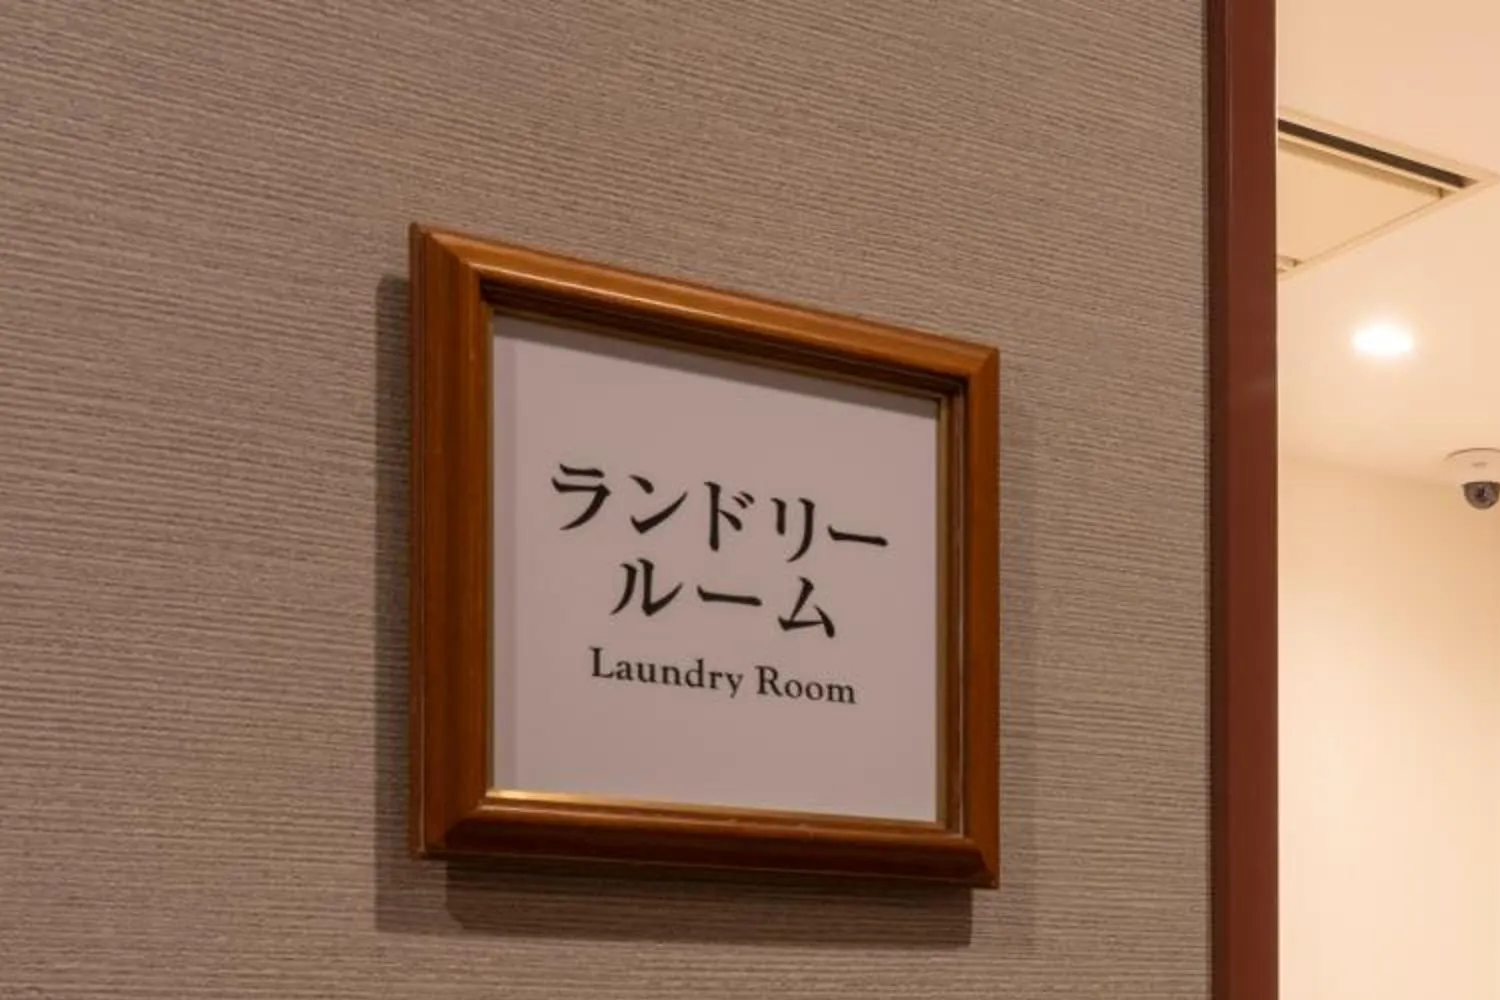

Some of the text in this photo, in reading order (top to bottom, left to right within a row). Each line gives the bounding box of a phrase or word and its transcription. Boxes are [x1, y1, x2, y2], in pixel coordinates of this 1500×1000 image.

[550, 461, 889, 564] ランドリー
[610, 558, 837, 640] ルーム
[589, 647, 857, 705] Laundry Room
